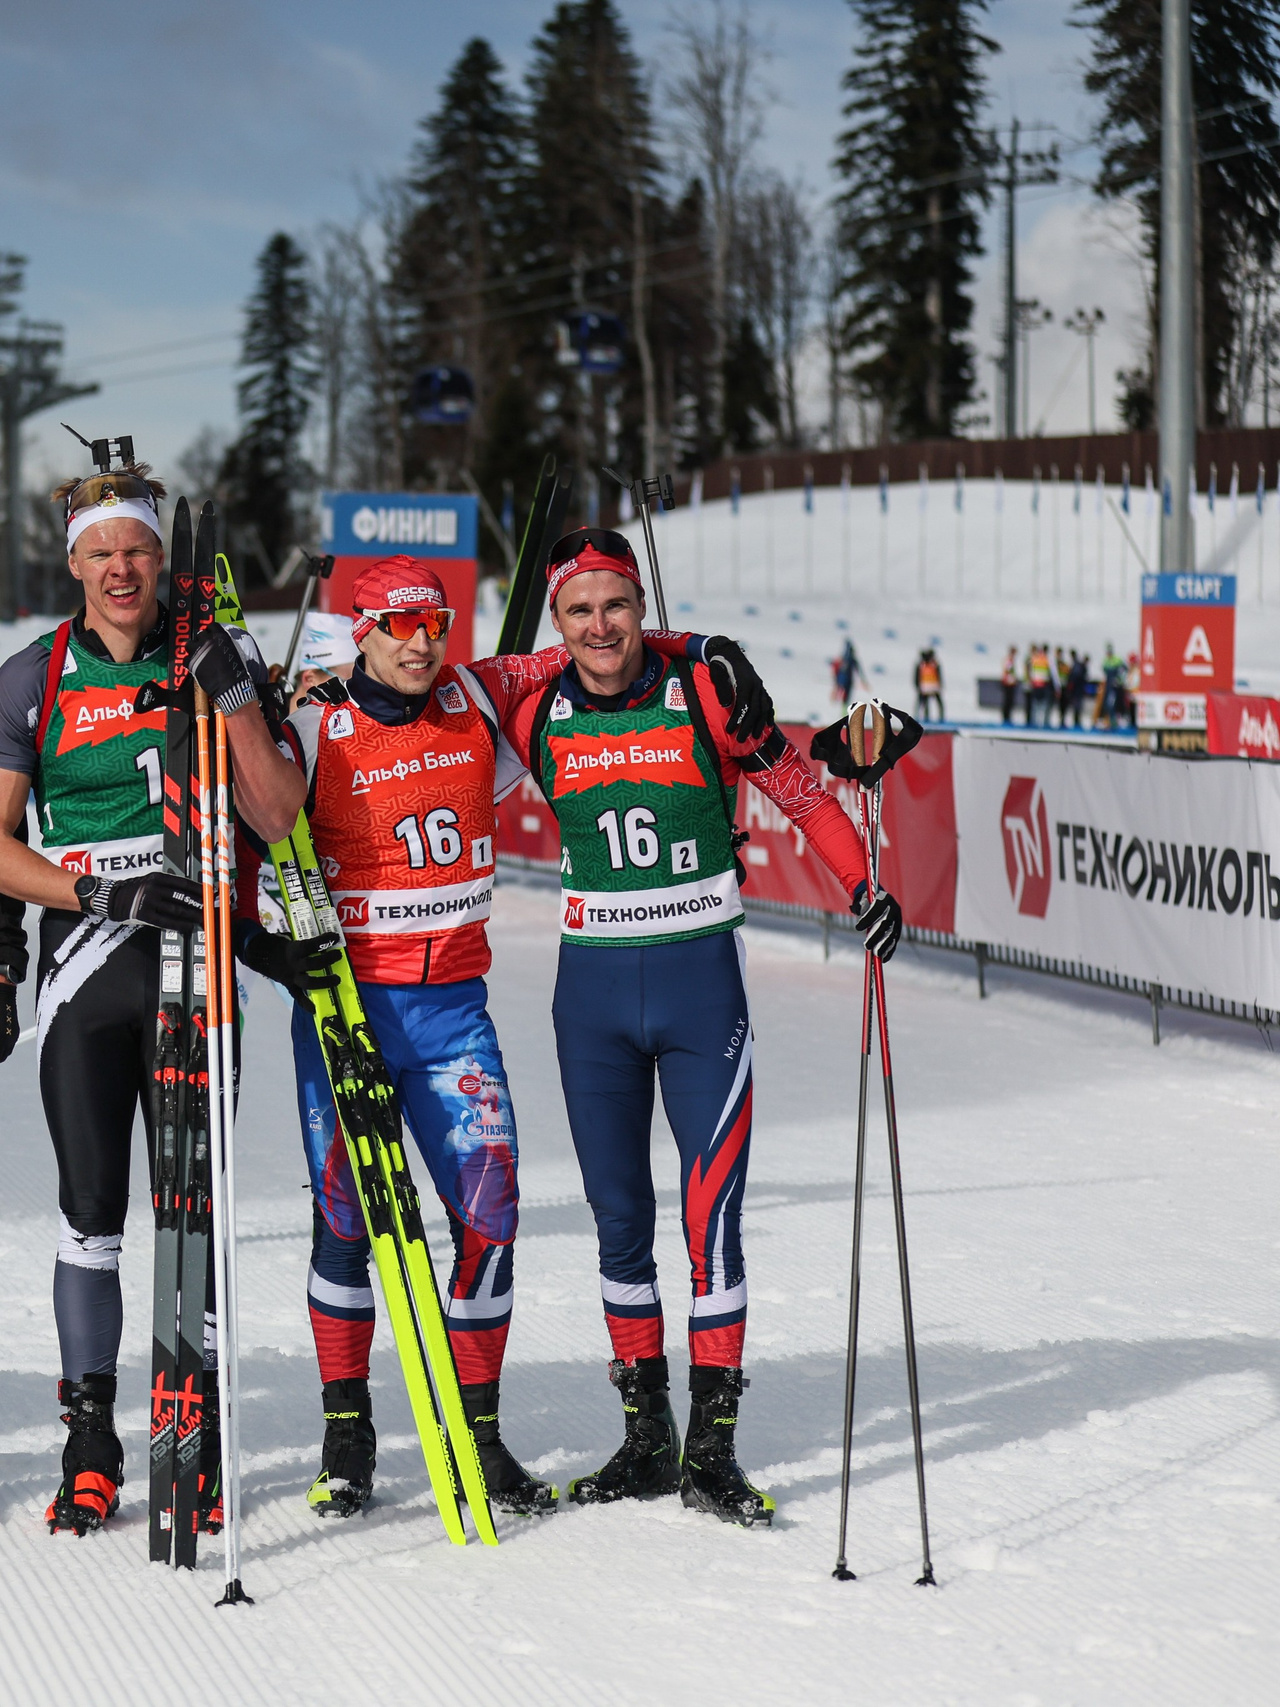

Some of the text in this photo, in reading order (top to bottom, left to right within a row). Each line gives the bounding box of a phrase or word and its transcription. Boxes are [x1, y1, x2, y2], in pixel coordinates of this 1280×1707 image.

[351, 507, 458, 545] ФИНИШ
[387, 586, 442, 600] МОСОБЛ
[389, 595, 442, 607] СПОРТ
[1175, 576, 1222, 600] СТАРТ
[442, 692, 459, 701] 2025
[446, 701, 463, 709] 2026
[671, 689, 684, 697] 202
[76, 698, 134, 733] Альф
[134, 746, 164, 806] 1
[351, 750, 475, 795] Альфа Банк
[564, 745, 684, 779] Альфа Банк
[43, 802, 54, 830] 1
[394, 807, 462, 868] 16
[479, 842, 485, 862] 1
[596, 805, 661, 870] 16
[679, 847, 692, 868] 2
[1057, 820, 1280, 921] ТЕХНОНИКОЛЬ
[588, 895, 722, 923] ТЕХНОНИКОЛЬ
[723, 1018, 746, 1060] MOAX
[474, 1412, 499, 1422] FISC
[151, 1432, 175, 1462] 193
[177, 1435, 201, 1465] 193
